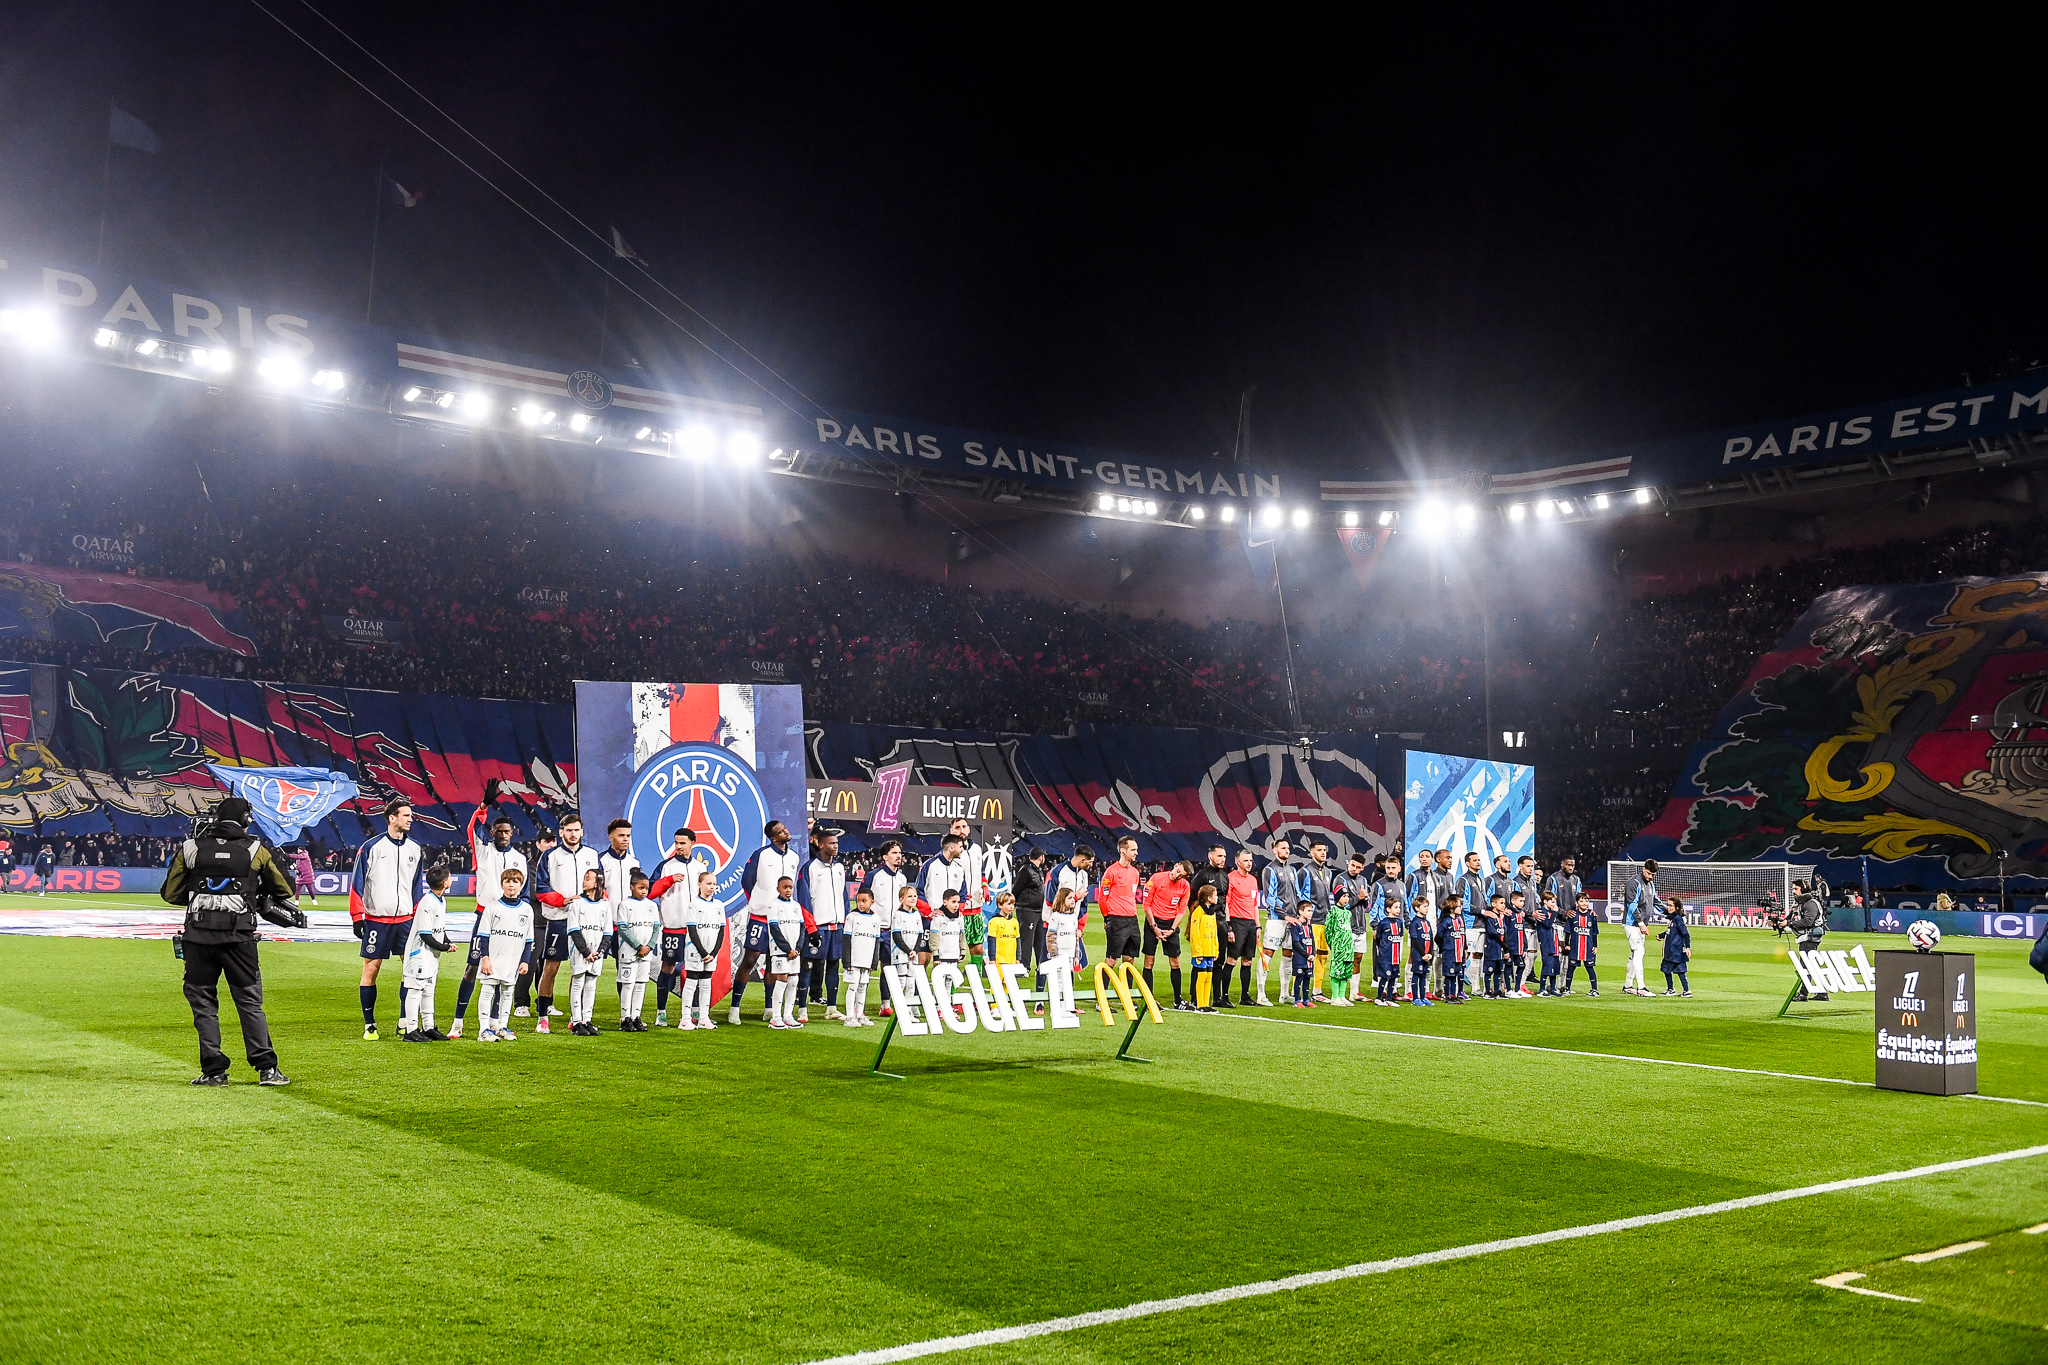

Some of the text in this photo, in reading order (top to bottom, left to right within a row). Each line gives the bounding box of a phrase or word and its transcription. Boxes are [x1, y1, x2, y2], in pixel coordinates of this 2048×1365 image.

[42, 267, 315, 357] PARIS
[574, 373, 603, 385] PARIS
[1722, 417, 1872, 465] PARIS
[1891, 395, 1995, 438] EST
[816, 418, 1280, 498] PARIS SAINT-GERMAIN
[72, 534, 135, 554] QATAR
[88, 551, 135, 563] AIRWAYS
[522, 587, 569, 602] QATAR
[343, 618, 384, 631] QATAR
[353, 629, 384, 637] AIRWAYS
[751, 660, 784, 672] QATAR
[650, 759, 741, 799] PARIS
[922, 794, 965, 819] LIGUE
[750, 924, 764, 939] 51
[1983, 914, 2034, 937] ICI
[368, 930, 378, 945] 8
[491, 929, 524, 940] CMA CGM
[551, 933, 559, 947] 7
[665, 936, 679, 950] 33
[1788, 949, 1867, 994] LIGUE
[883, 963, 1045, 1036] LIGUE
[1893, 996, 1926, 1012] LIGUE 1
[1878, 1028, 1943, 1053] Équipier
[1945, 1033, 1977, 1055] Équipier
[1876, 1046, 1945, 1065] du match
[1955, 1050, 1978, 1065] match
